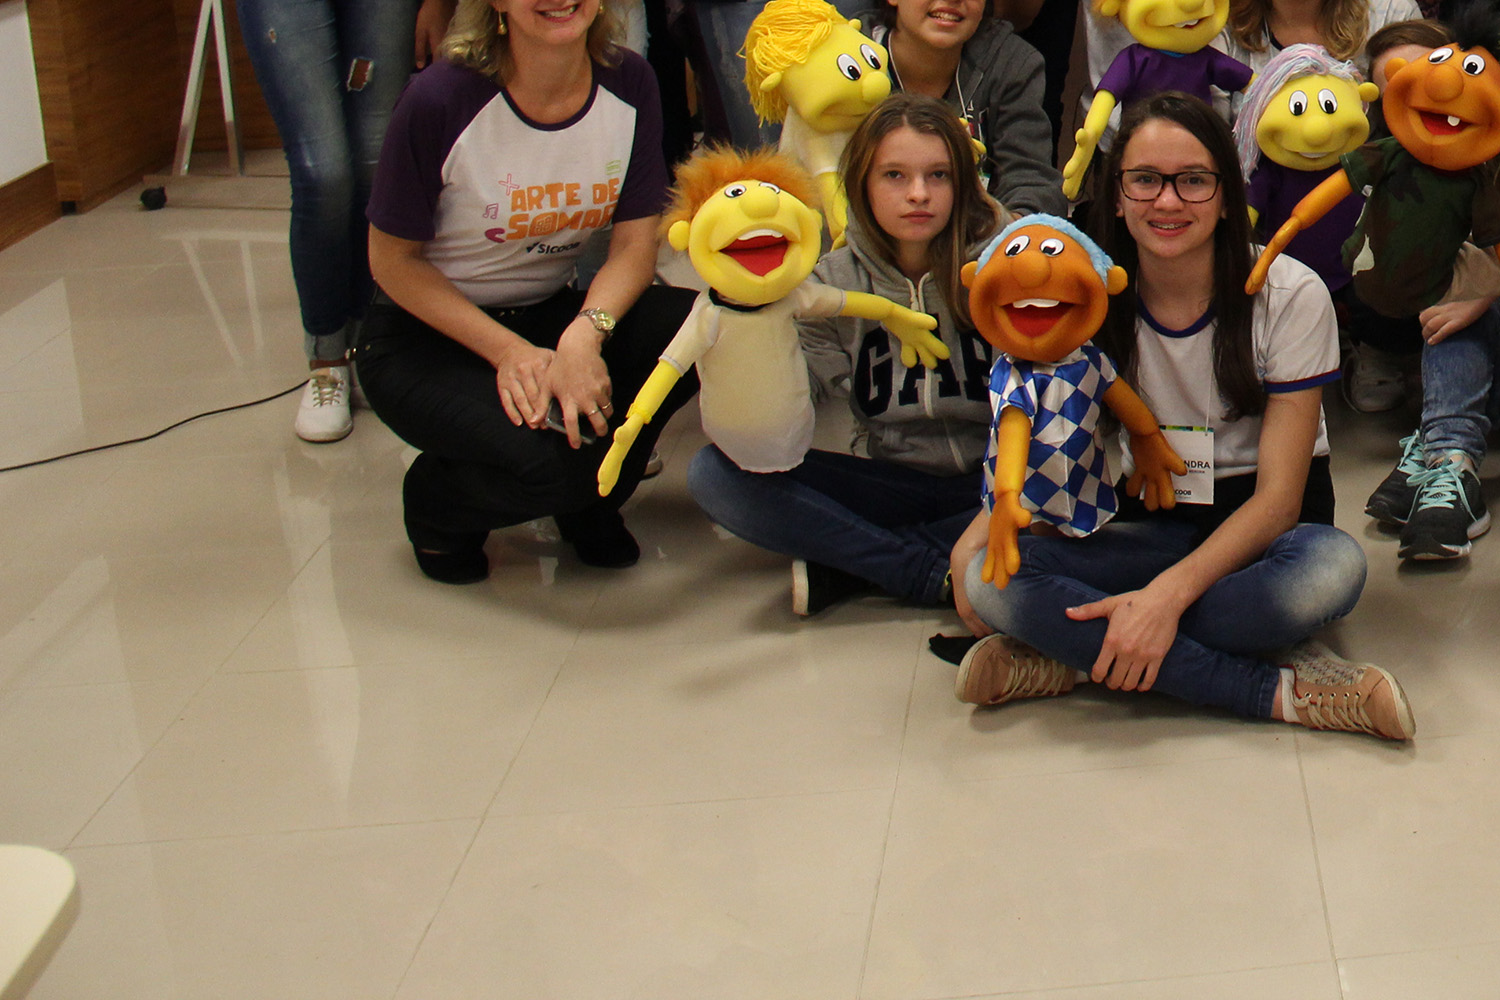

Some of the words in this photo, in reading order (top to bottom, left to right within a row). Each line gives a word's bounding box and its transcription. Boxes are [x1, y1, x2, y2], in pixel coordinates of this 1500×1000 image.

[511, 182, 582, 212] ARTE
[592, 177, 620, 205] DE
[1184, 460, 1211, 469] NDRA
